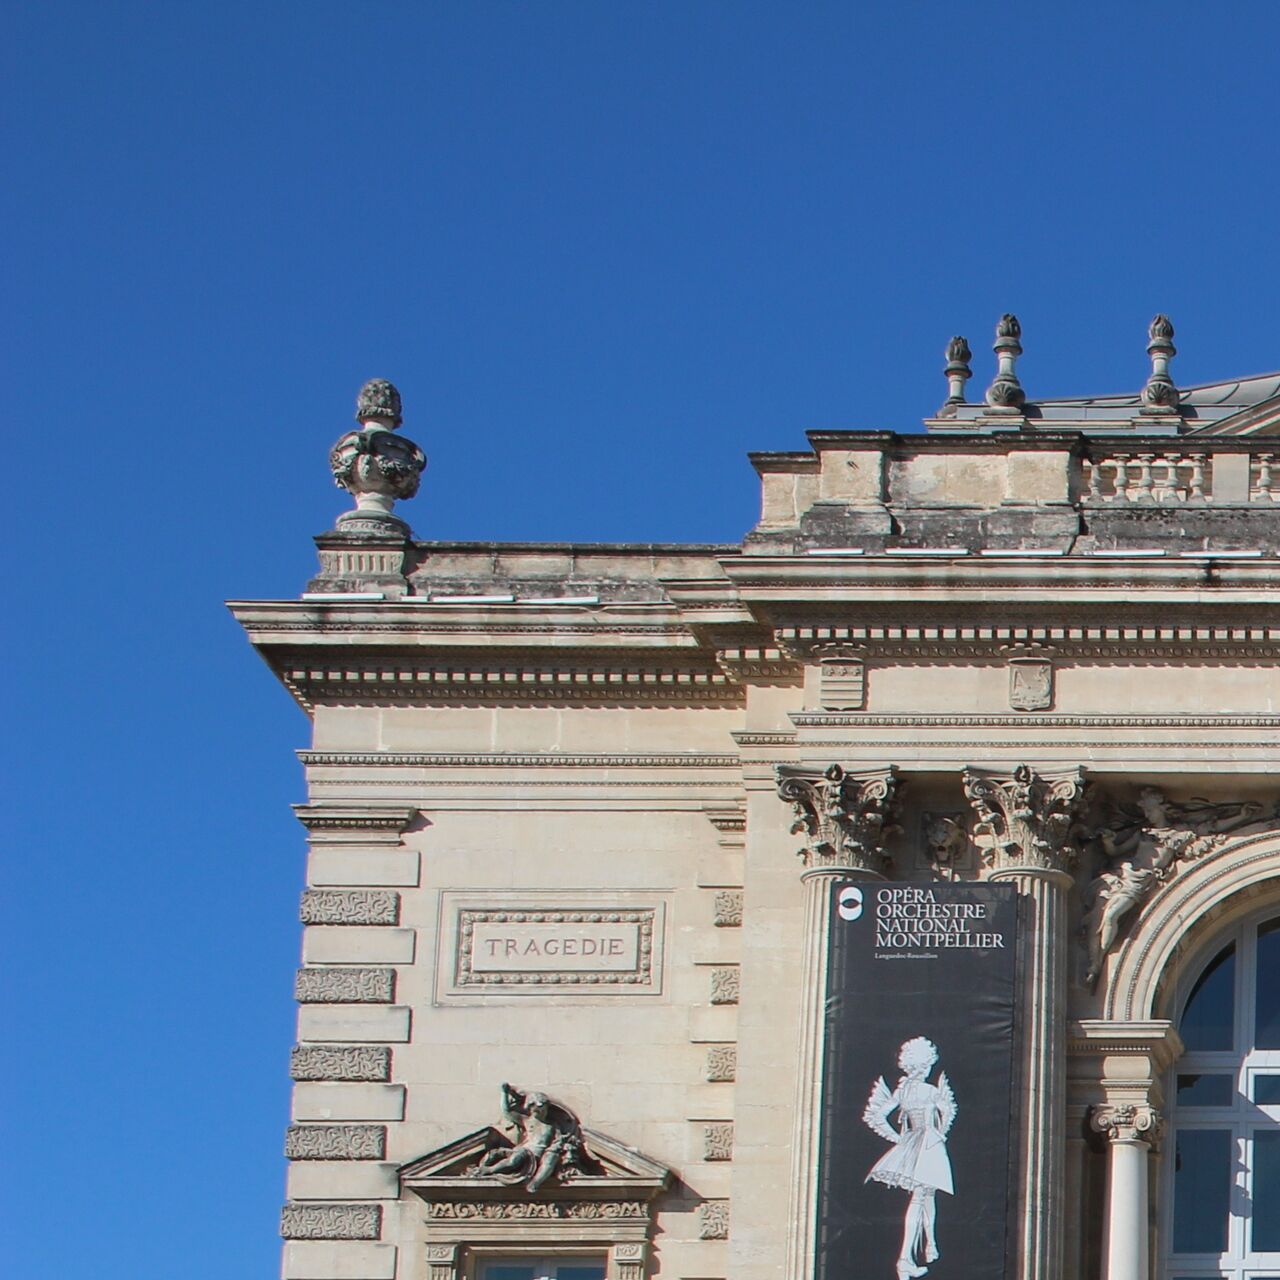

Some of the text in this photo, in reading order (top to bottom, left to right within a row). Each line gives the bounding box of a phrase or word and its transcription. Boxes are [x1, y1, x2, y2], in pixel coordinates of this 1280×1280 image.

[876, 887, 936, 903] OPÉRA
[876, 904, 986, 919] ORCHESTRE
[875, 918, 970, 933] NATIONAL
[485, 939, 625, 956] TRAGEDIE
[875, 933, 1005, 948] MONTPELLIER
